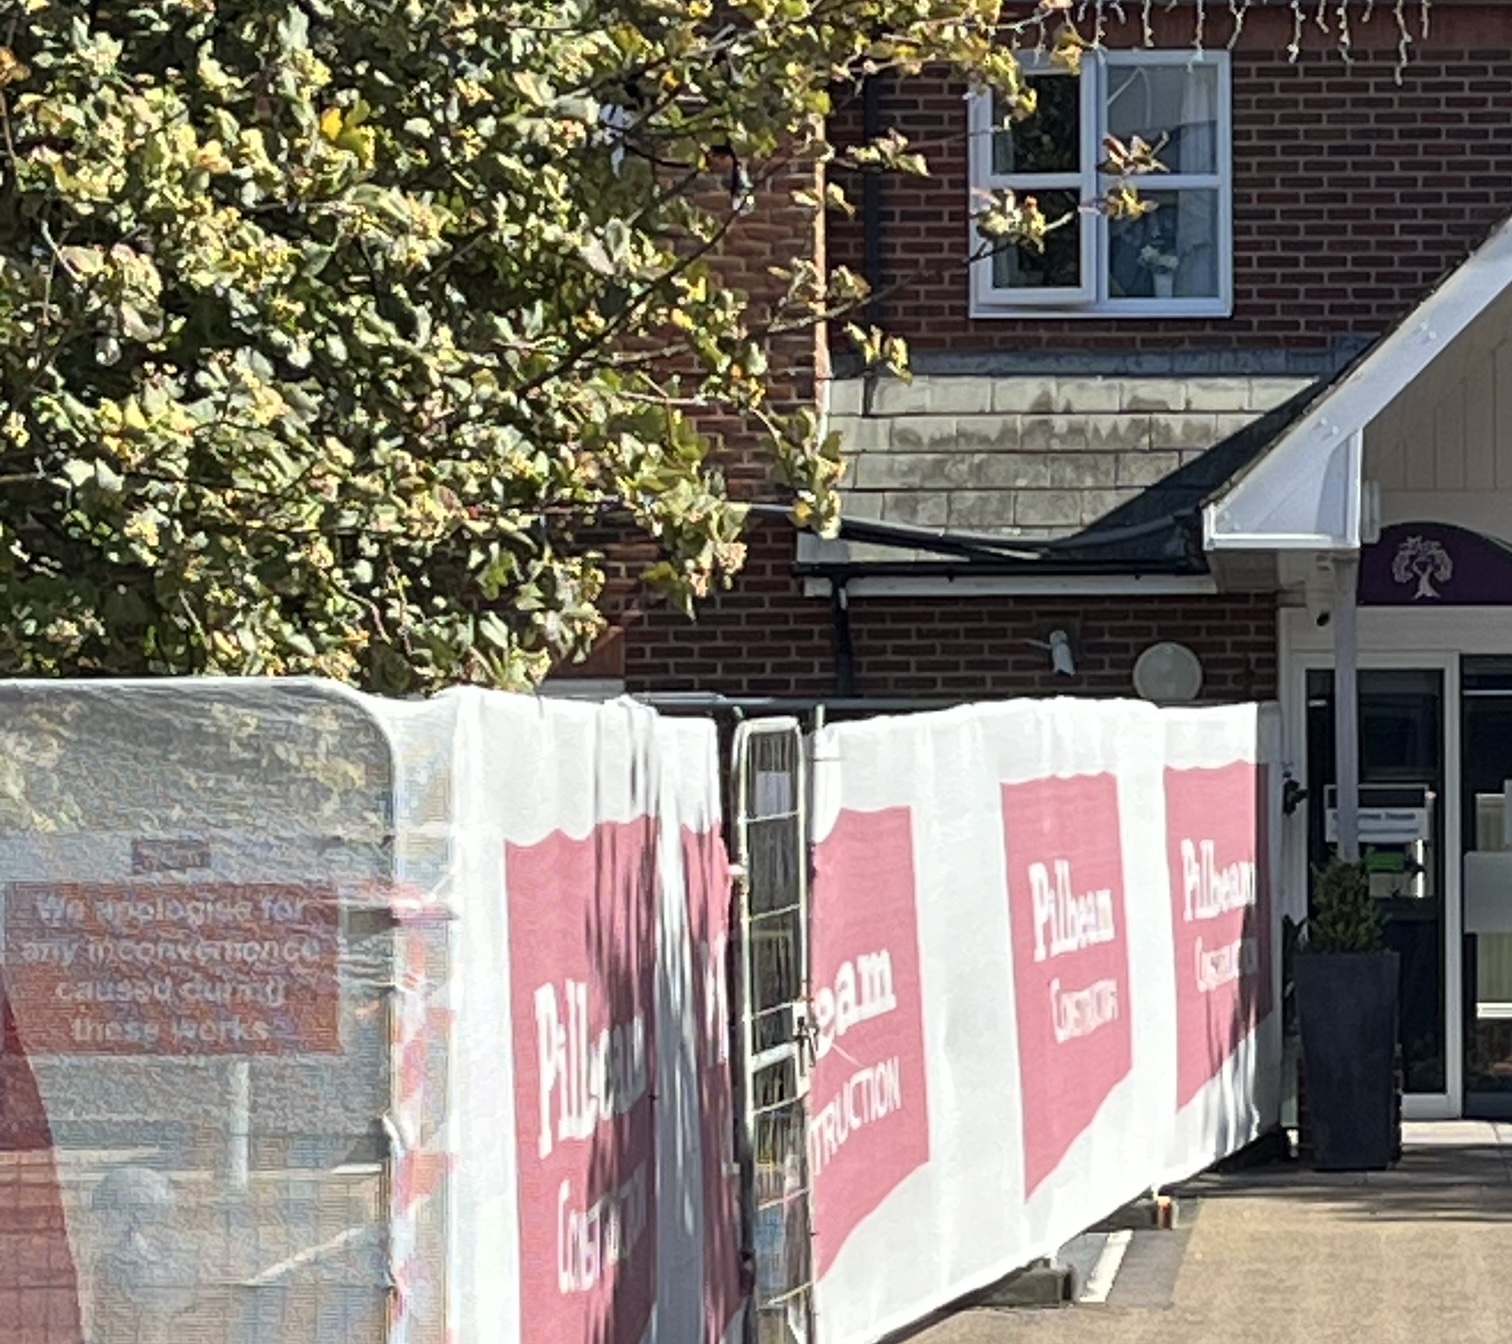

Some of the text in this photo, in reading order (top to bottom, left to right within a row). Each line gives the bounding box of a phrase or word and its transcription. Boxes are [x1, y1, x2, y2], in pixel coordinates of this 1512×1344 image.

[37, 894, 85, 922] We
[260, 894, 305, 920] for
[1028, 858, 1115, 963] Pilbeam
[21, 940, 80, 965] any
[55, 977, 287, 1008] caused during
[71, 1017, 272, 1043] these works
